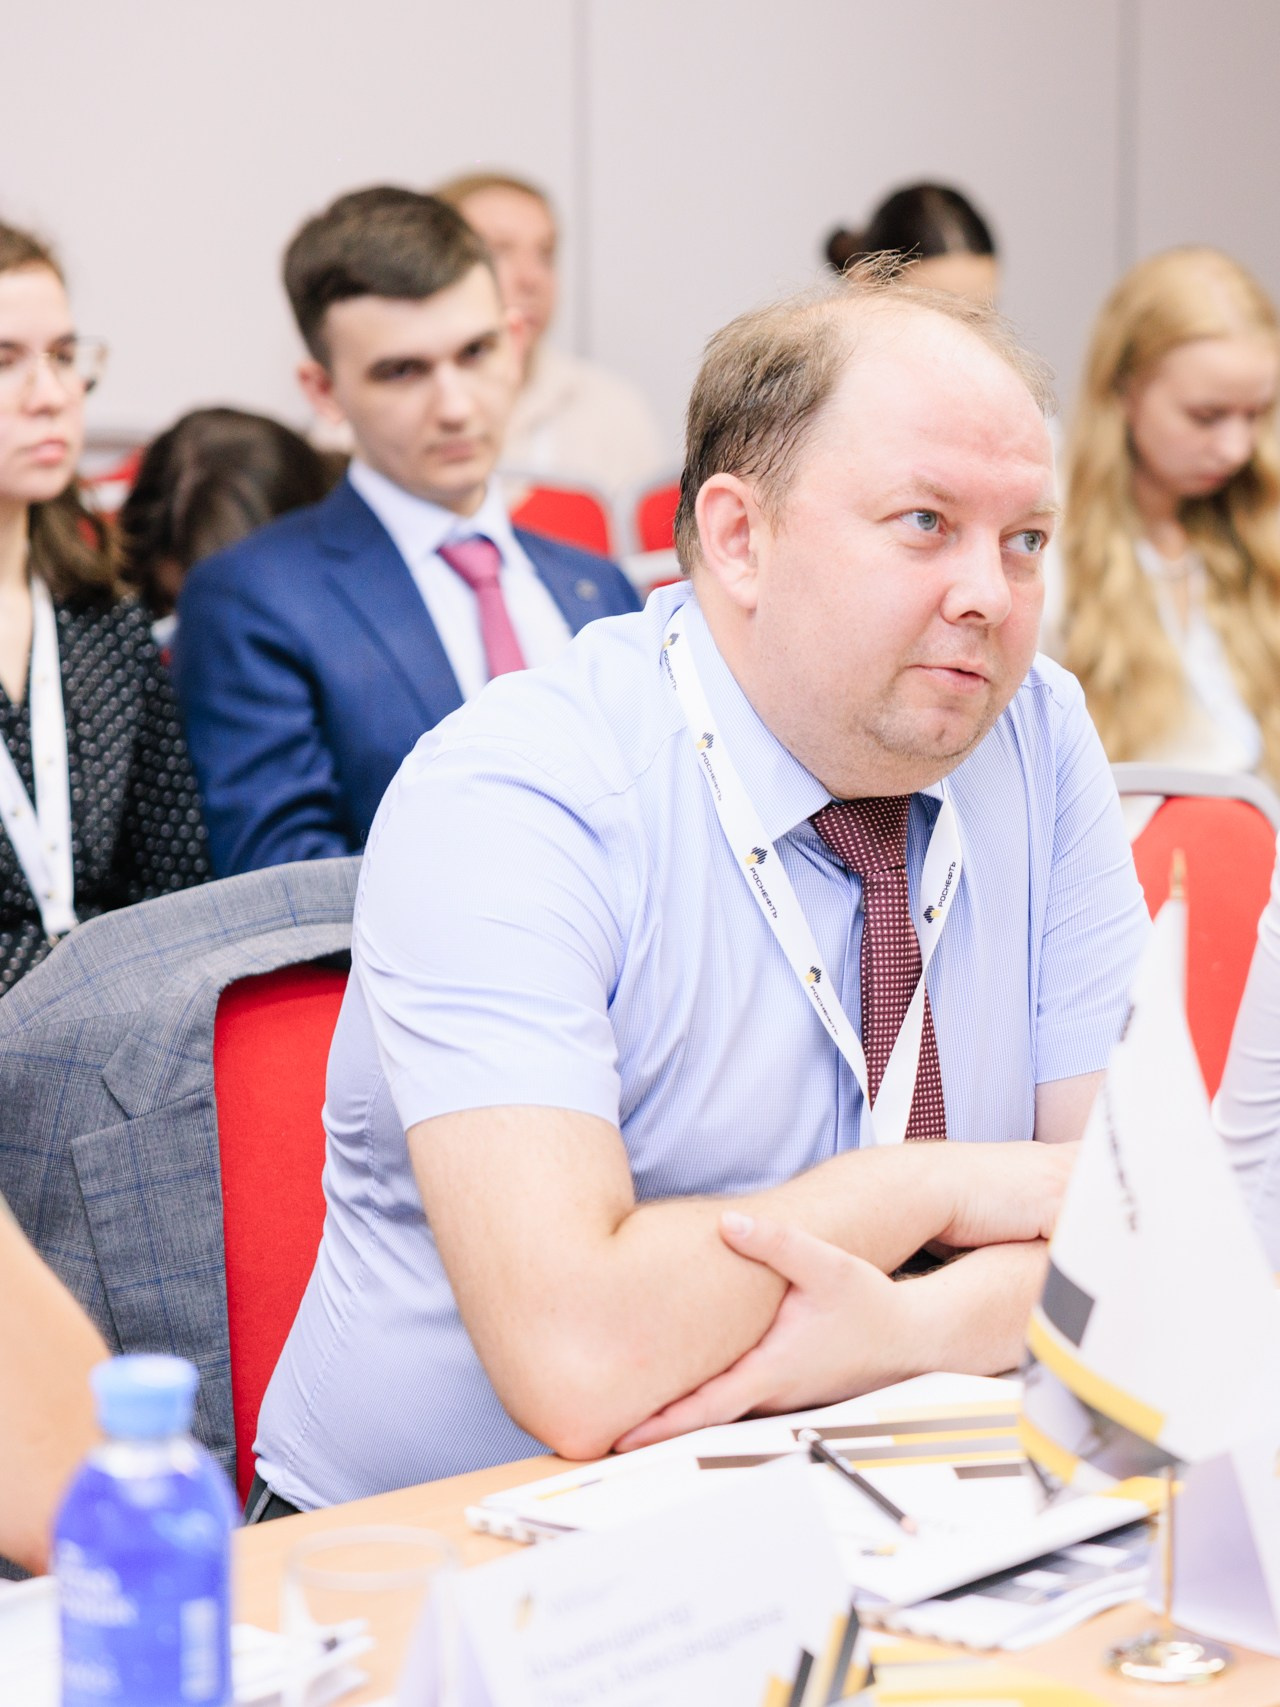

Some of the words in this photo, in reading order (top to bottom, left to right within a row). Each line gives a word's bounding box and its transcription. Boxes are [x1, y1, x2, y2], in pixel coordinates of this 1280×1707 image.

[701, 751, 722, 802] РОСНЕФТЬ
[750, 867, 778, 919] РОСНЕФТЬ
[938, 861, 956, 908] РОСНЕФТЬ
